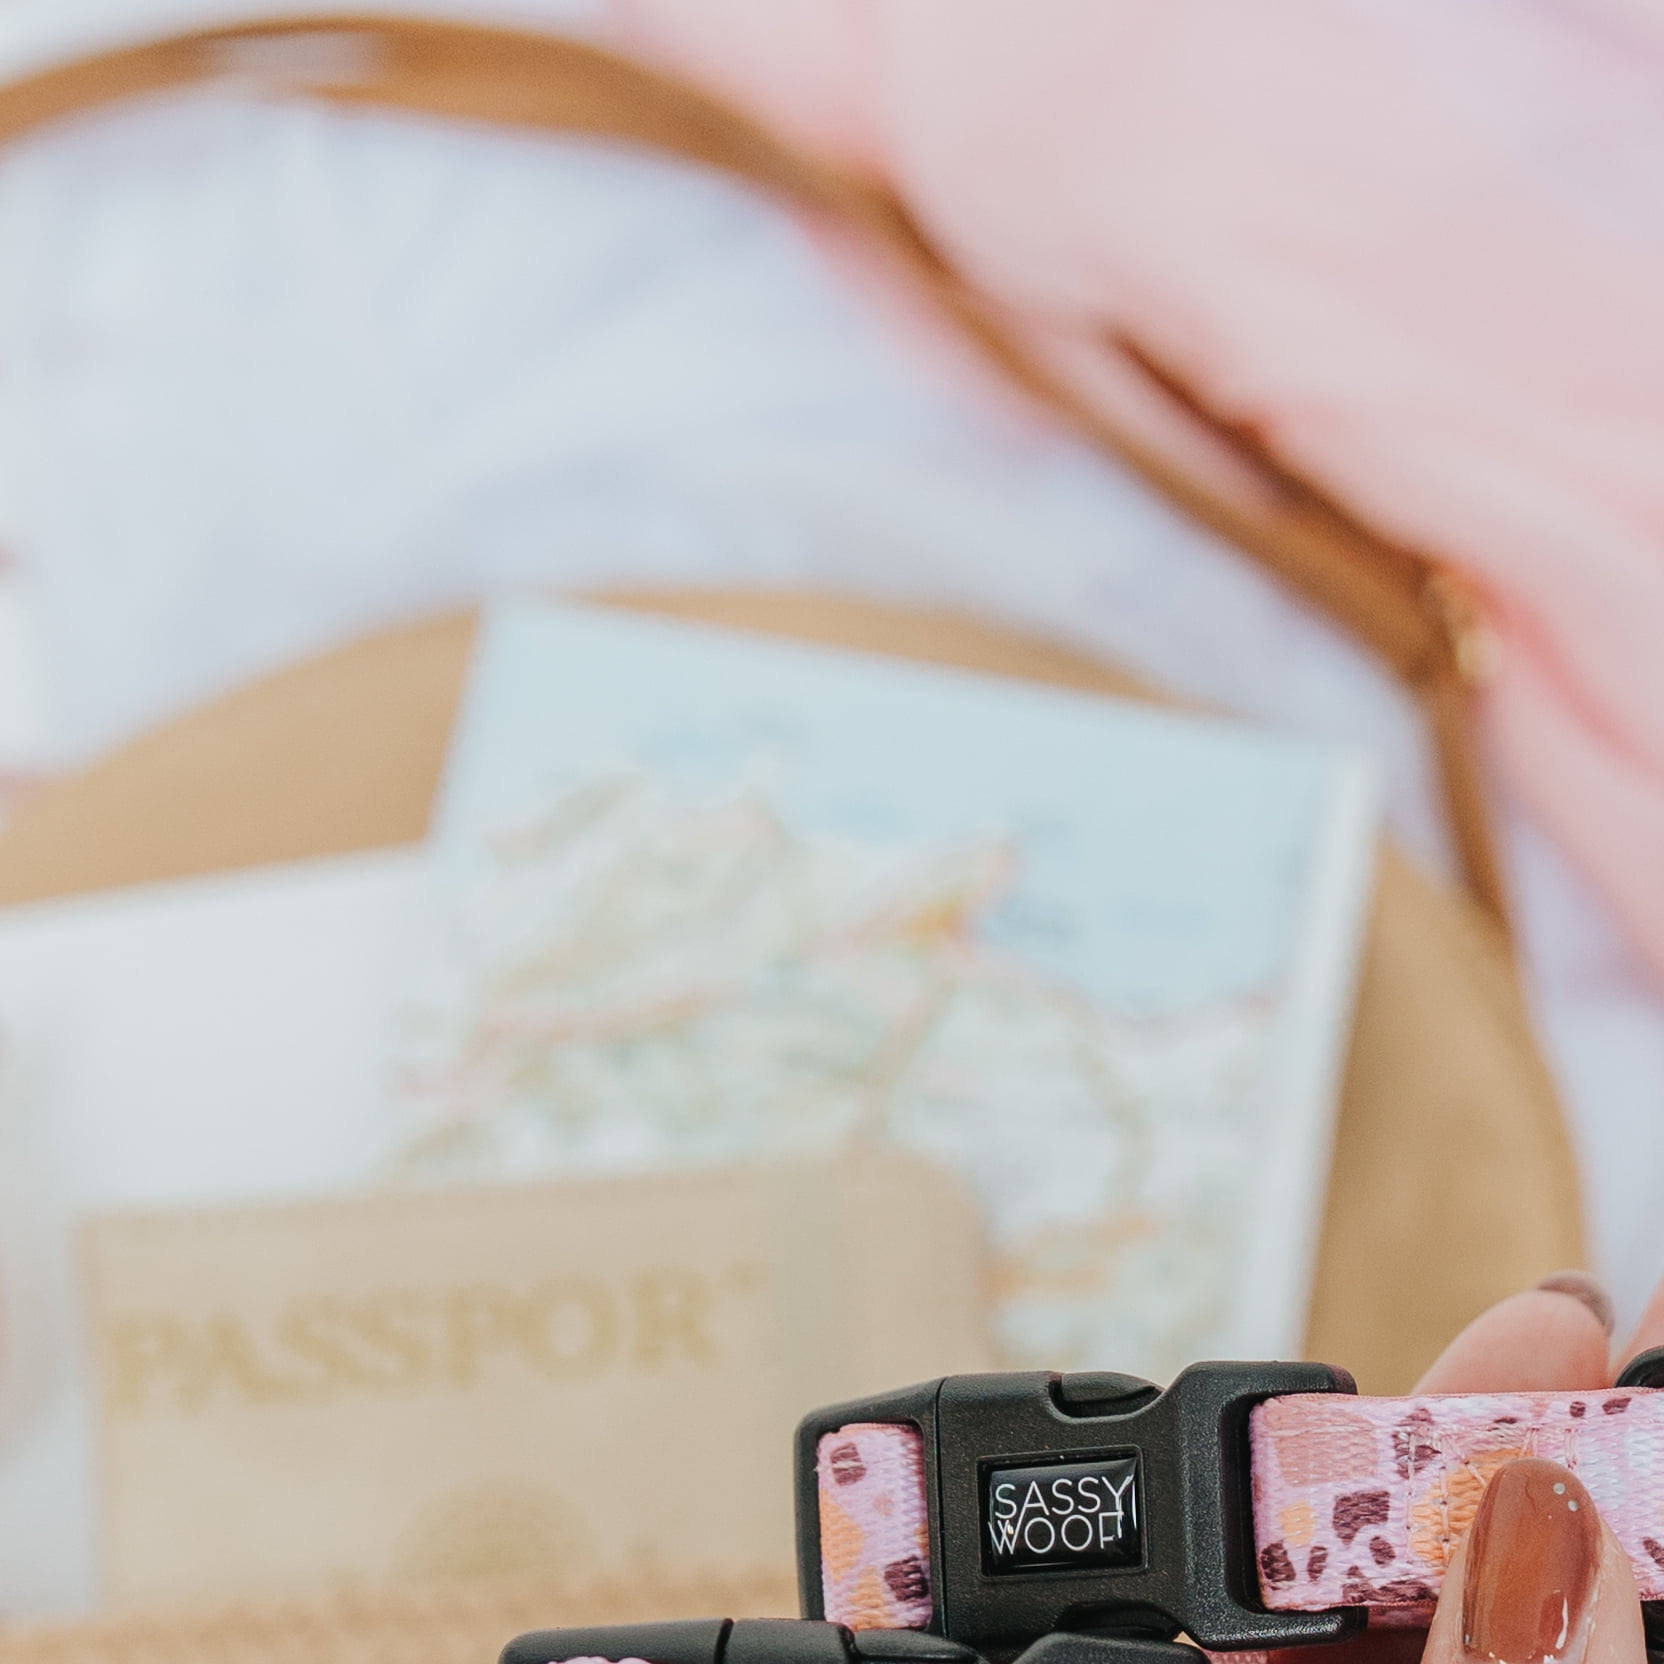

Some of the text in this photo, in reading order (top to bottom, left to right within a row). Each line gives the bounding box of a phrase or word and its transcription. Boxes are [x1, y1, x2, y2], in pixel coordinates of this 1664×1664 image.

[102, 1258, 768, 1420] PASSPOR
[994, 1475, 1135, 1521] SASSY
[987, 1510, 1124, 1555] WOOF
